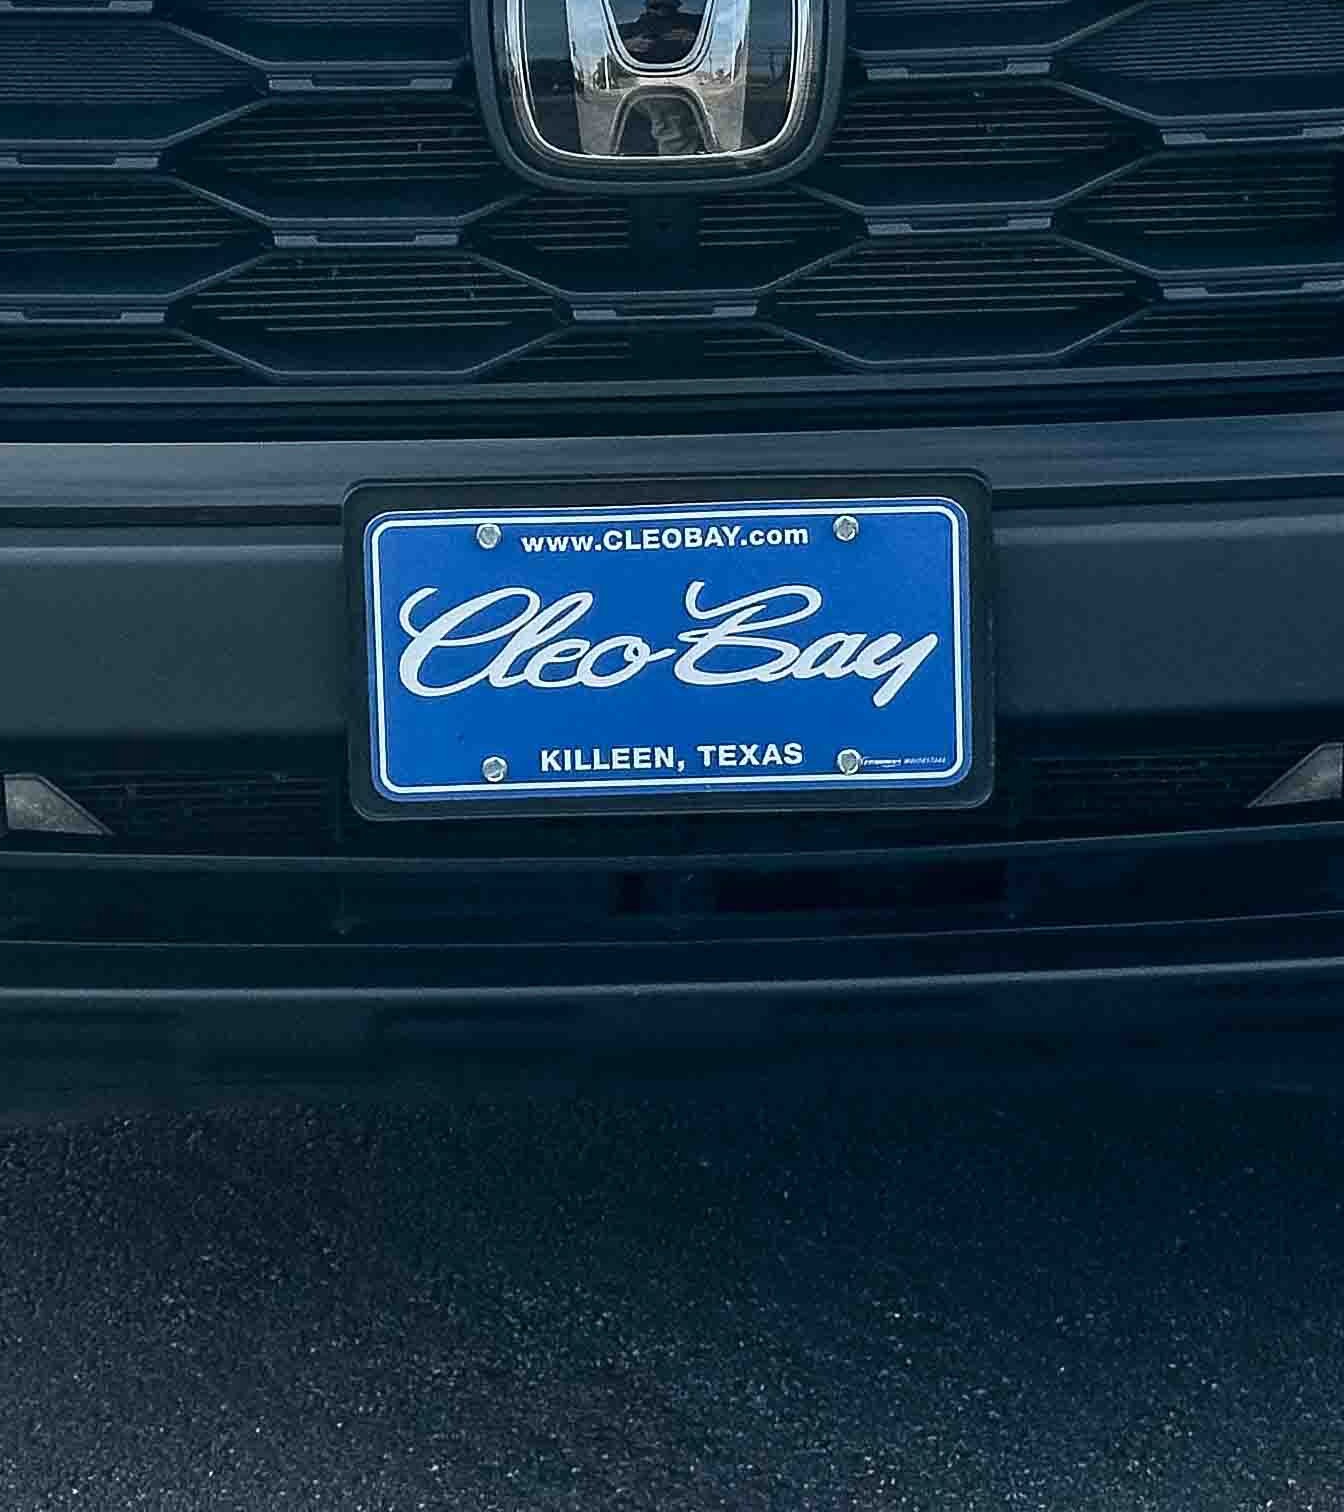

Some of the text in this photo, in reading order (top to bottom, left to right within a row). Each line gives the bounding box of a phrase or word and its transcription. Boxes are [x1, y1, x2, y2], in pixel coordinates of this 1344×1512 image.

[520, 524, 810, 553] www.CLEOBAY.com
[399, 581, 939, 708] Cleo Bay
[540, 742, 804, 773] KILLEEN, TEXAS
